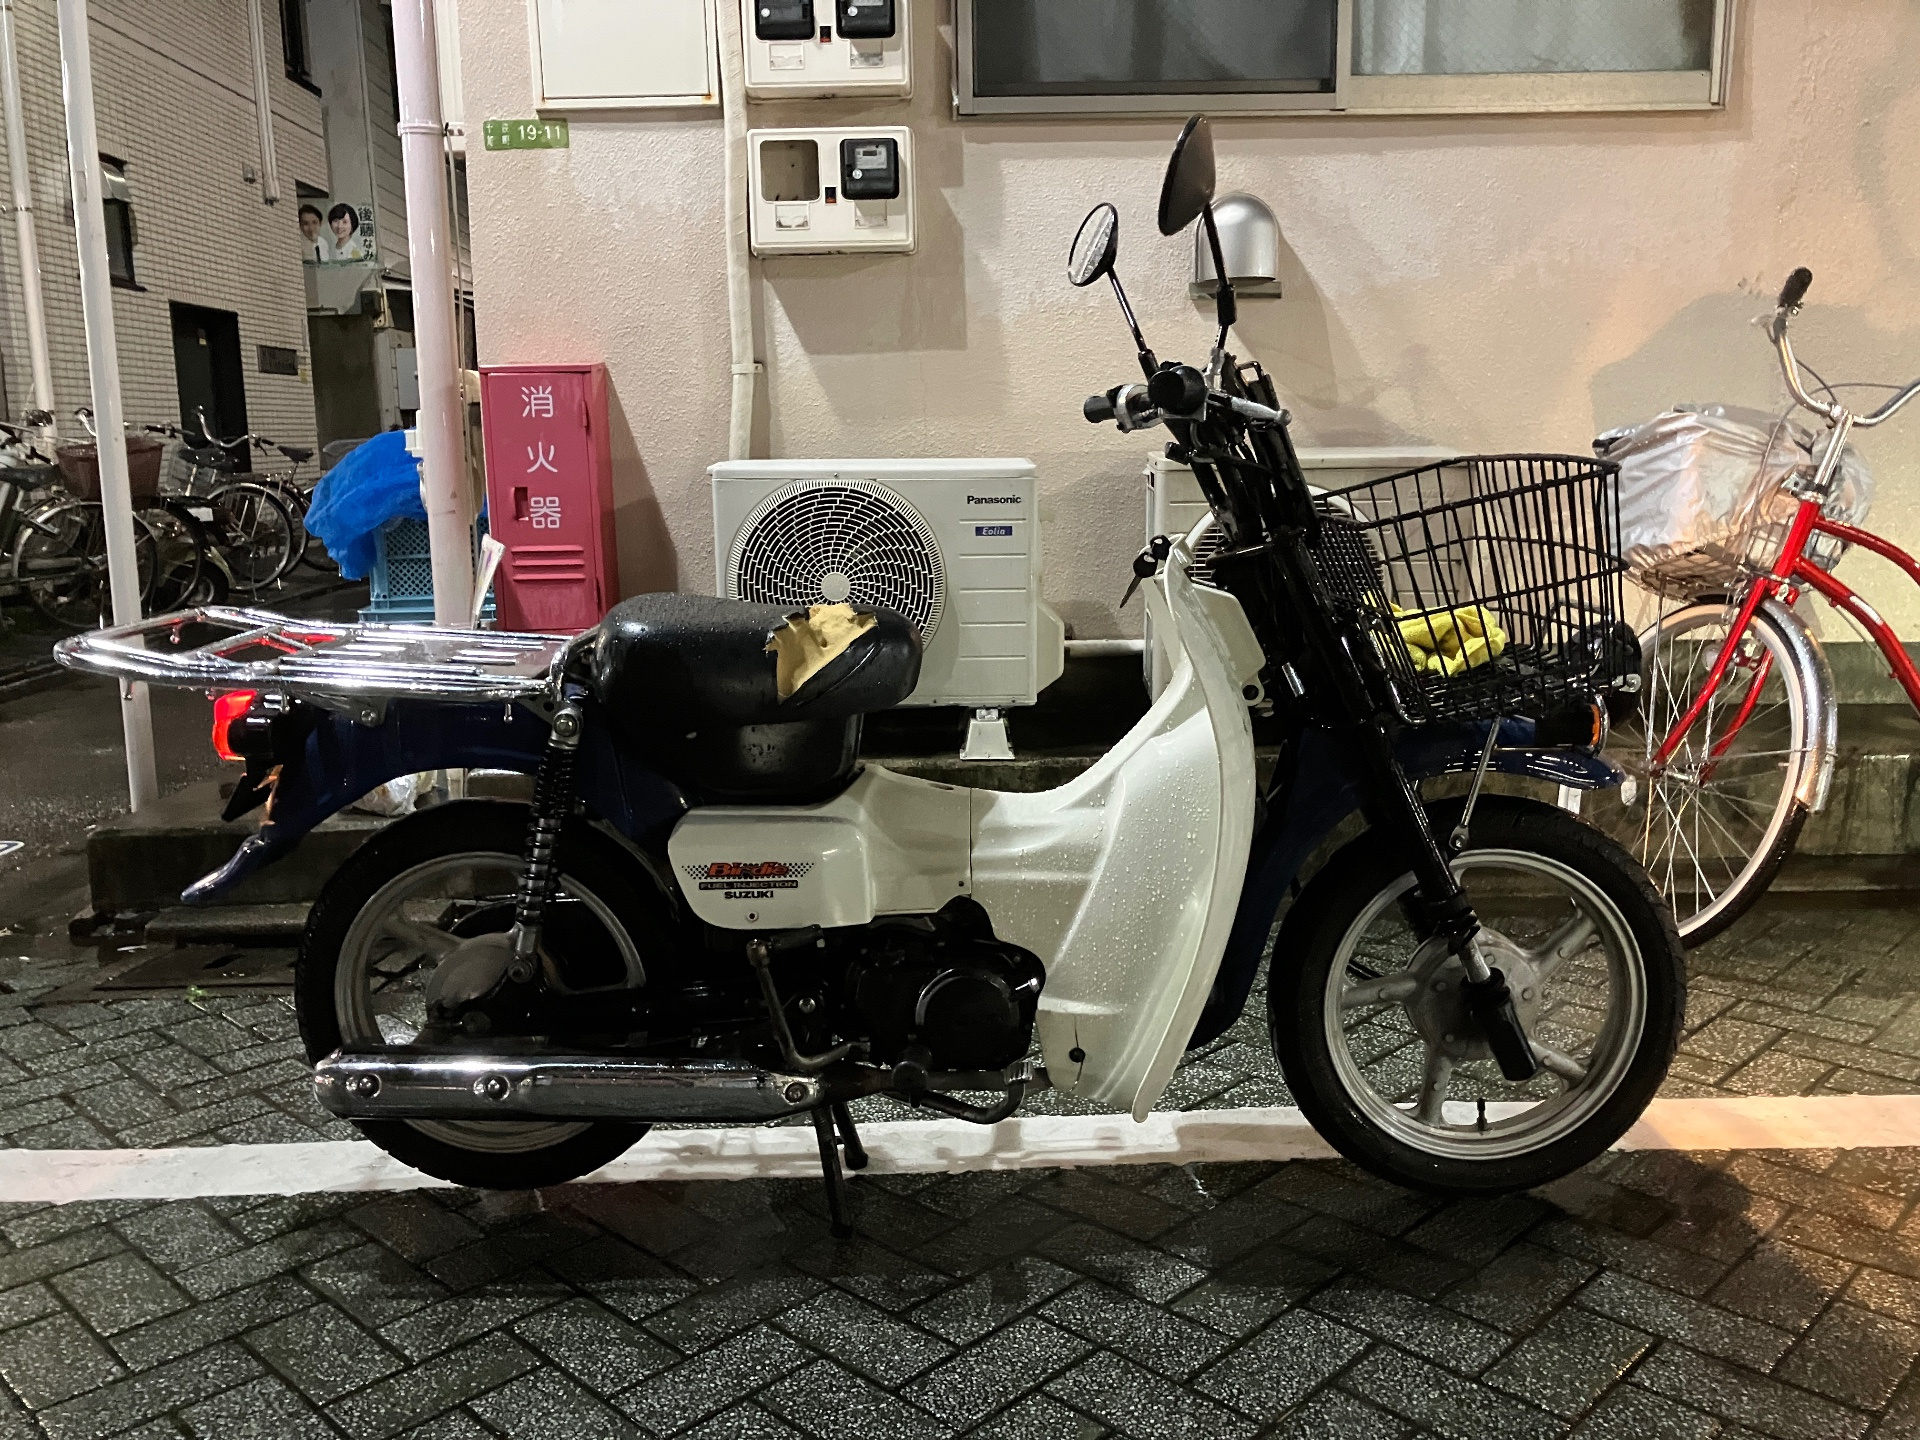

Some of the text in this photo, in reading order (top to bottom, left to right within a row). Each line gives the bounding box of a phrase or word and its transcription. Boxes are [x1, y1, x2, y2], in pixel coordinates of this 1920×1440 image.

[518, 124, 561, 140] 19-11
[521, 385, 561, 529] 消火器
[967, 494, 1021, 505] Panasonic
[707, 862, 790, 878] Birdie
[700, 880, 797, 889] FUEL INJECTION
[724, 890, 774, 899] SUZUKI
